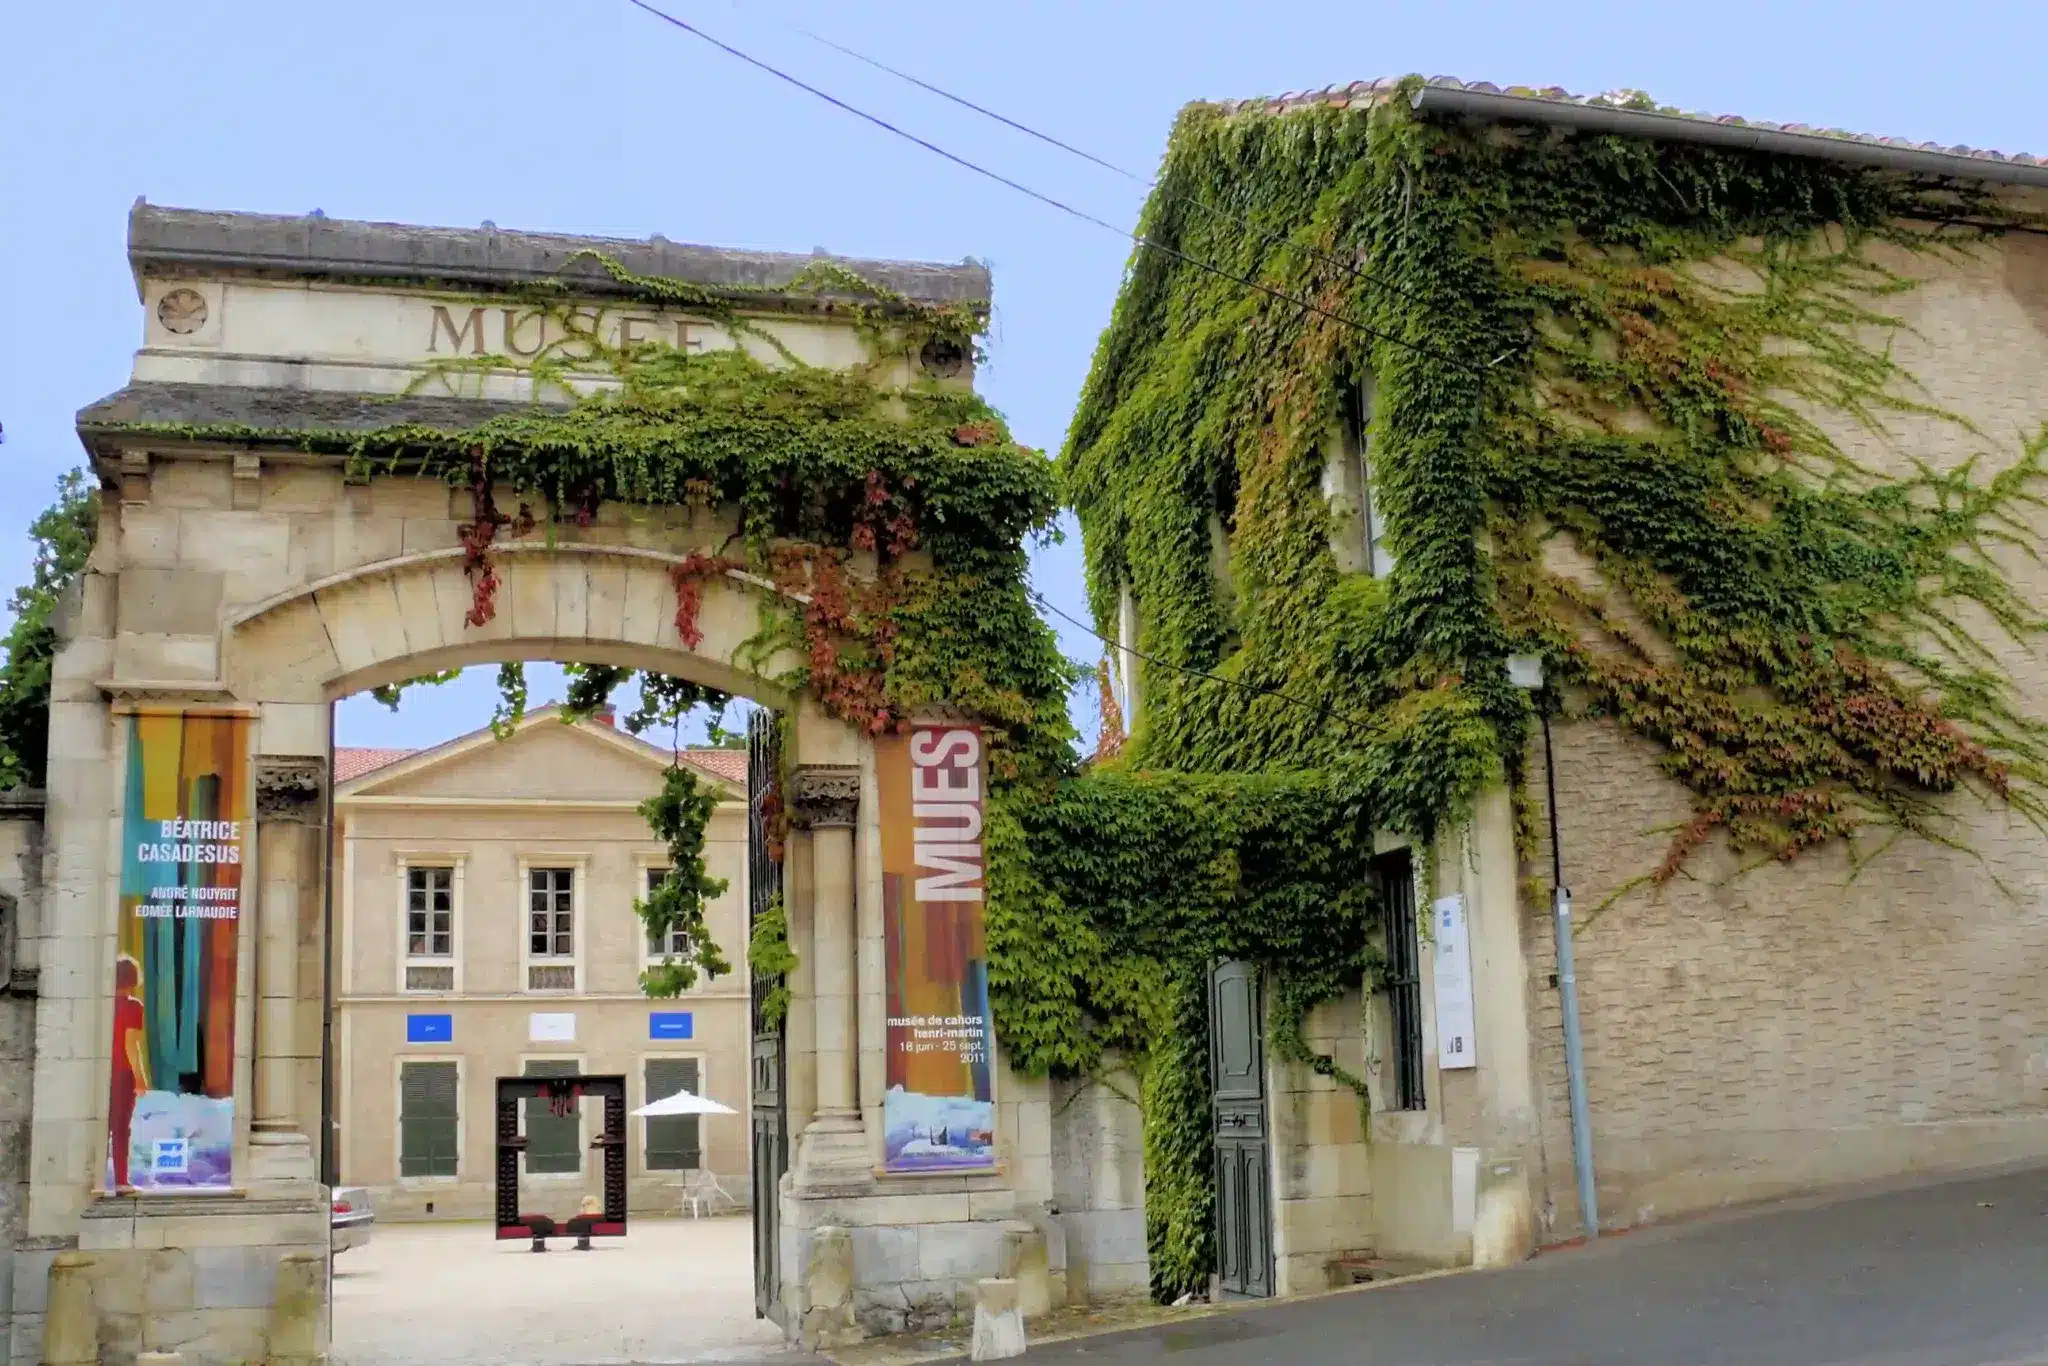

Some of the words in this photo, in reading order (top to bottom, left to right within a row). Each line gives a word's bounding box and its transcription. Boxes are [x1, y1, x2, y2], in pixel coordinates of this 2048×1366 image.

[911, 729, 983, 902] MUES
[161, 815, 241, 840] BÉATRICE
[138, 842, 240, 864] CASADESUS
[151, 884, 188, 900] ANDRÉ
[887, 1015, 925, 1027] musée
[927, 1014, 943, 1026] de
[944, 1014, 983, 1026] cahors
[913, 1027, 984, 1039] henri-martin
[942, 1040, 957, 1051] 25
[960, 1053, 985, 1064] 2011
